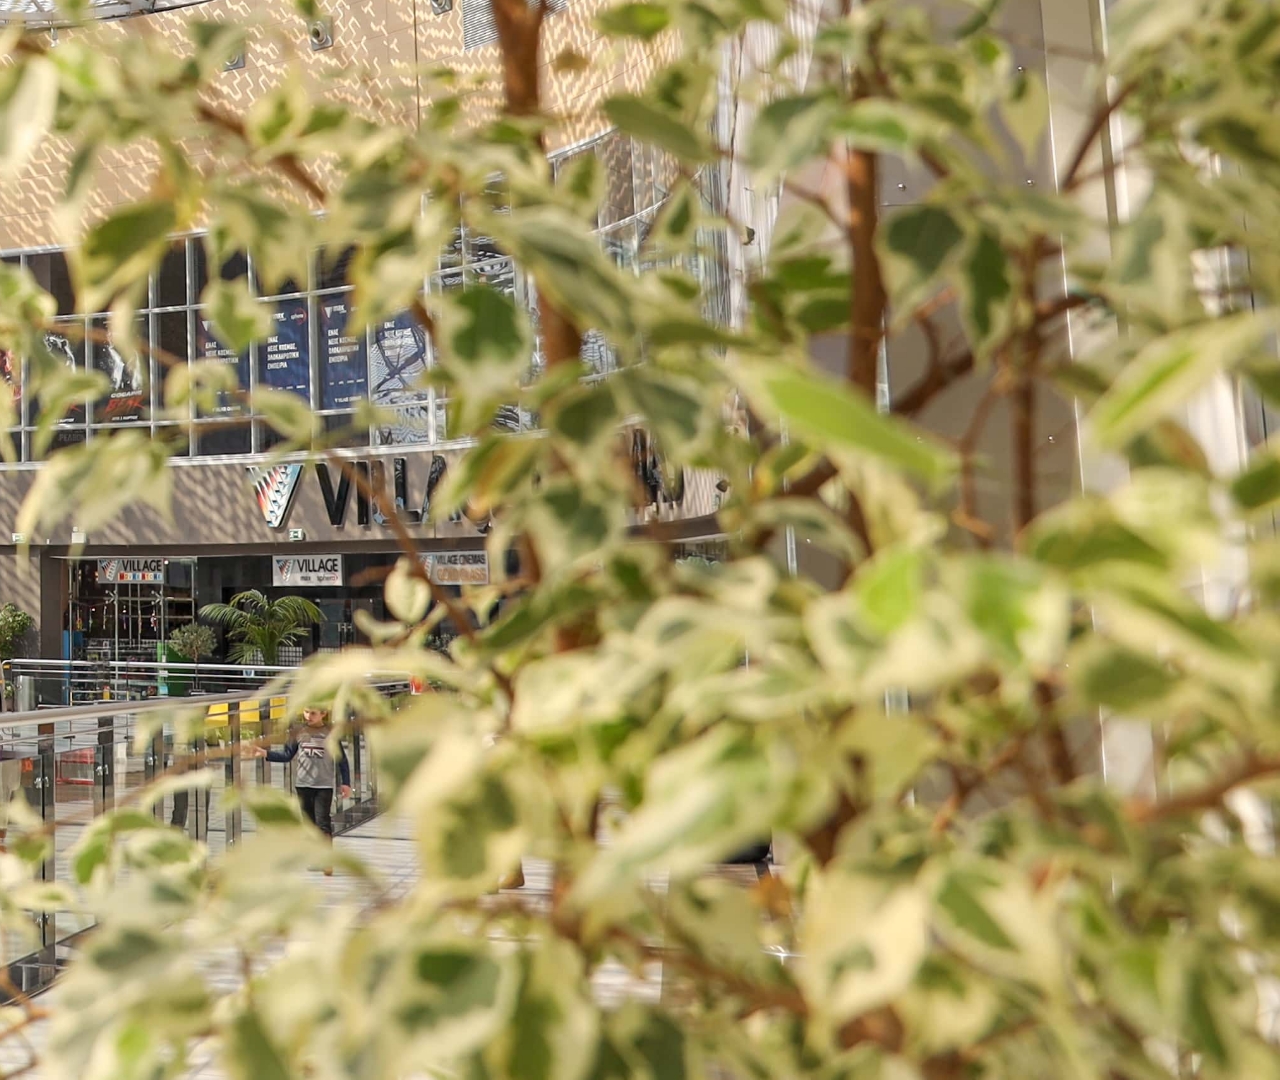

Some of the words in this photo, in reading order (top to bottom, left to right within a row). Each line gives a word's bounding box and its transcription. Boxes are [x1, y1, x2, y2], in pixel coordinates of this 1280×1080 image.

[315, 455, 492, 534] VILLA
[121, 559, 163, 572] VILLAGE
[296, 558, 339, 572] VILLAGE
